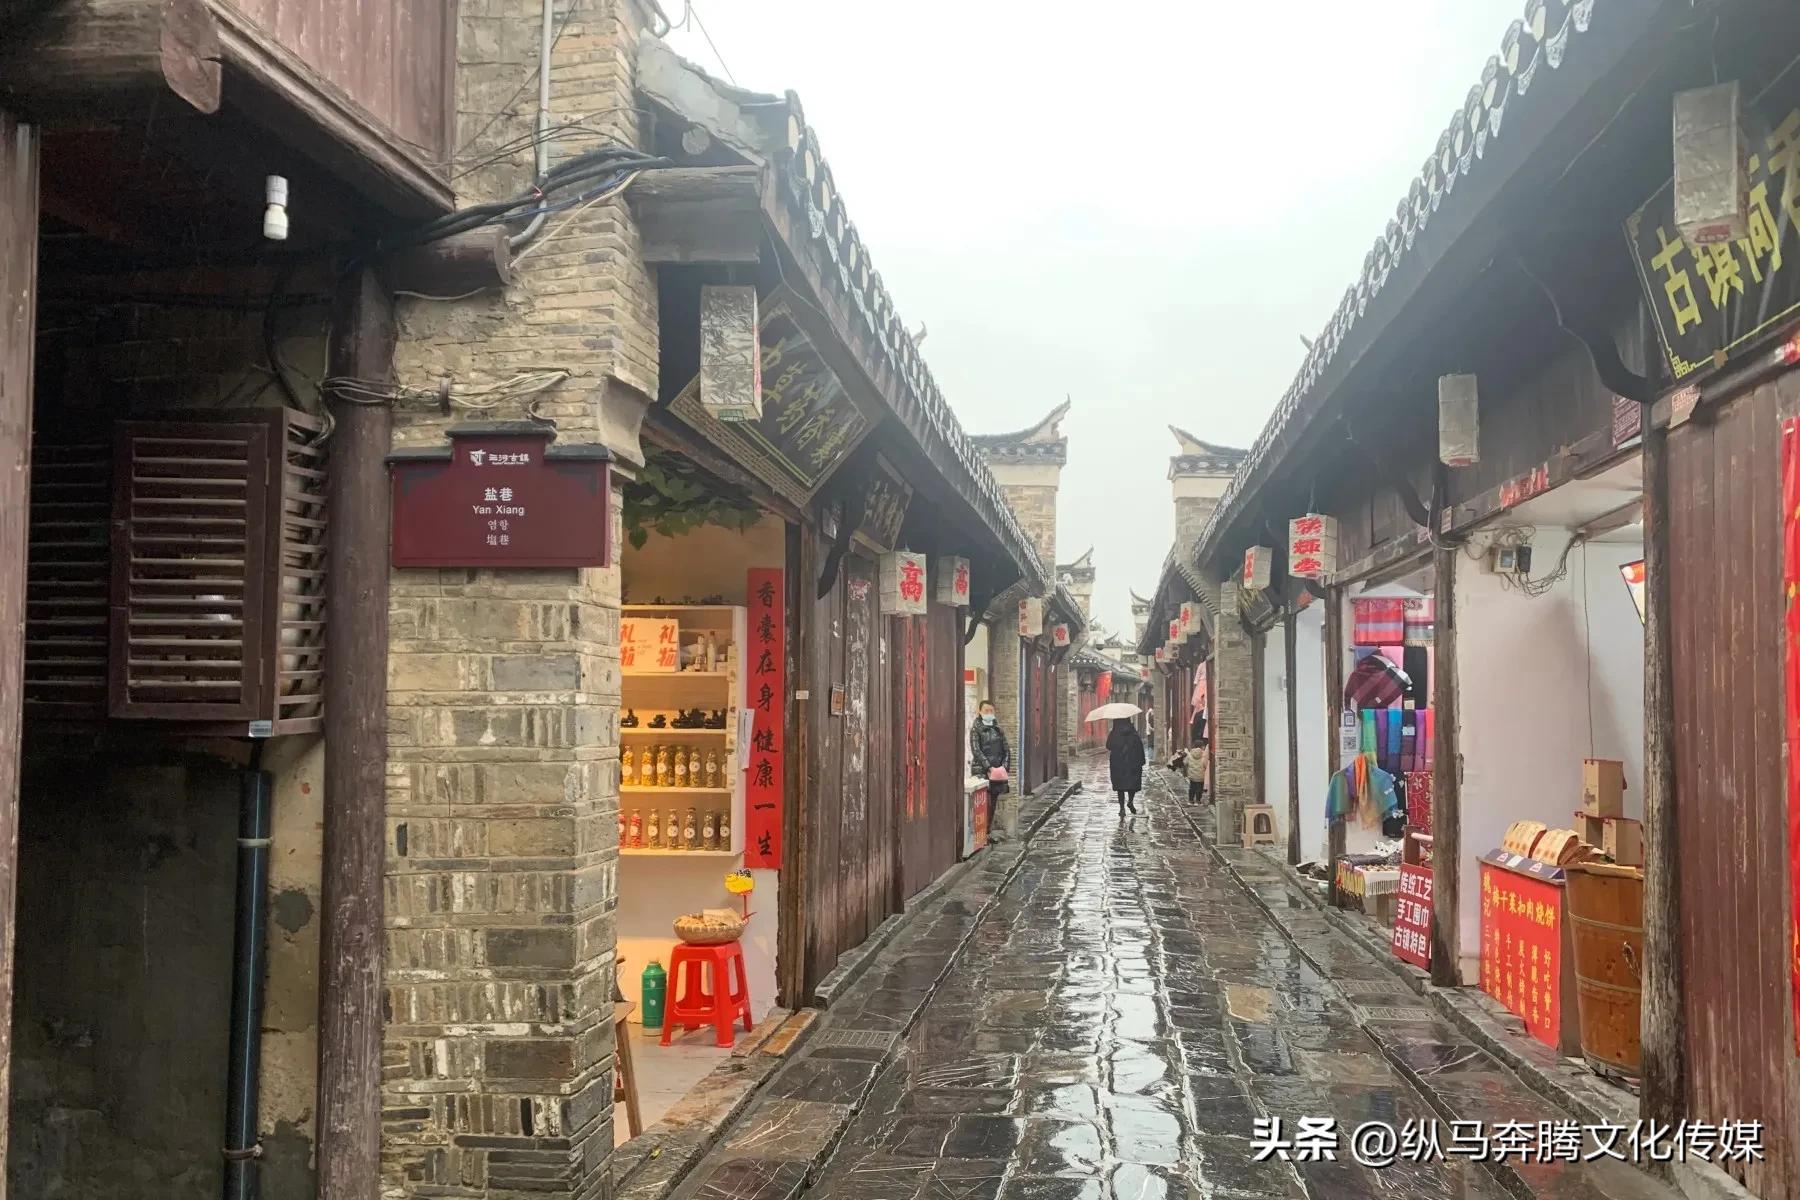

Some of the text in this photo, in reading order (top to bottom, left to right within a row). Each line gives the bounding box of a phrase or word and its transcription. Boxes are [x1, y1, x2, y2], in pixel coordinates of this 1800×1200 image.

[484, 487, 513, 501] 盐巷
[472, 505, 525, 516] Yan Xiang
[752, 581, 778, 857] 香囊在身健康一生
[1400, 871, 1433, 901] 传统工艺
[1397, 898, 1430, 929] 手工围巾
[1394, 925, 1427, 958] 古镇特色
